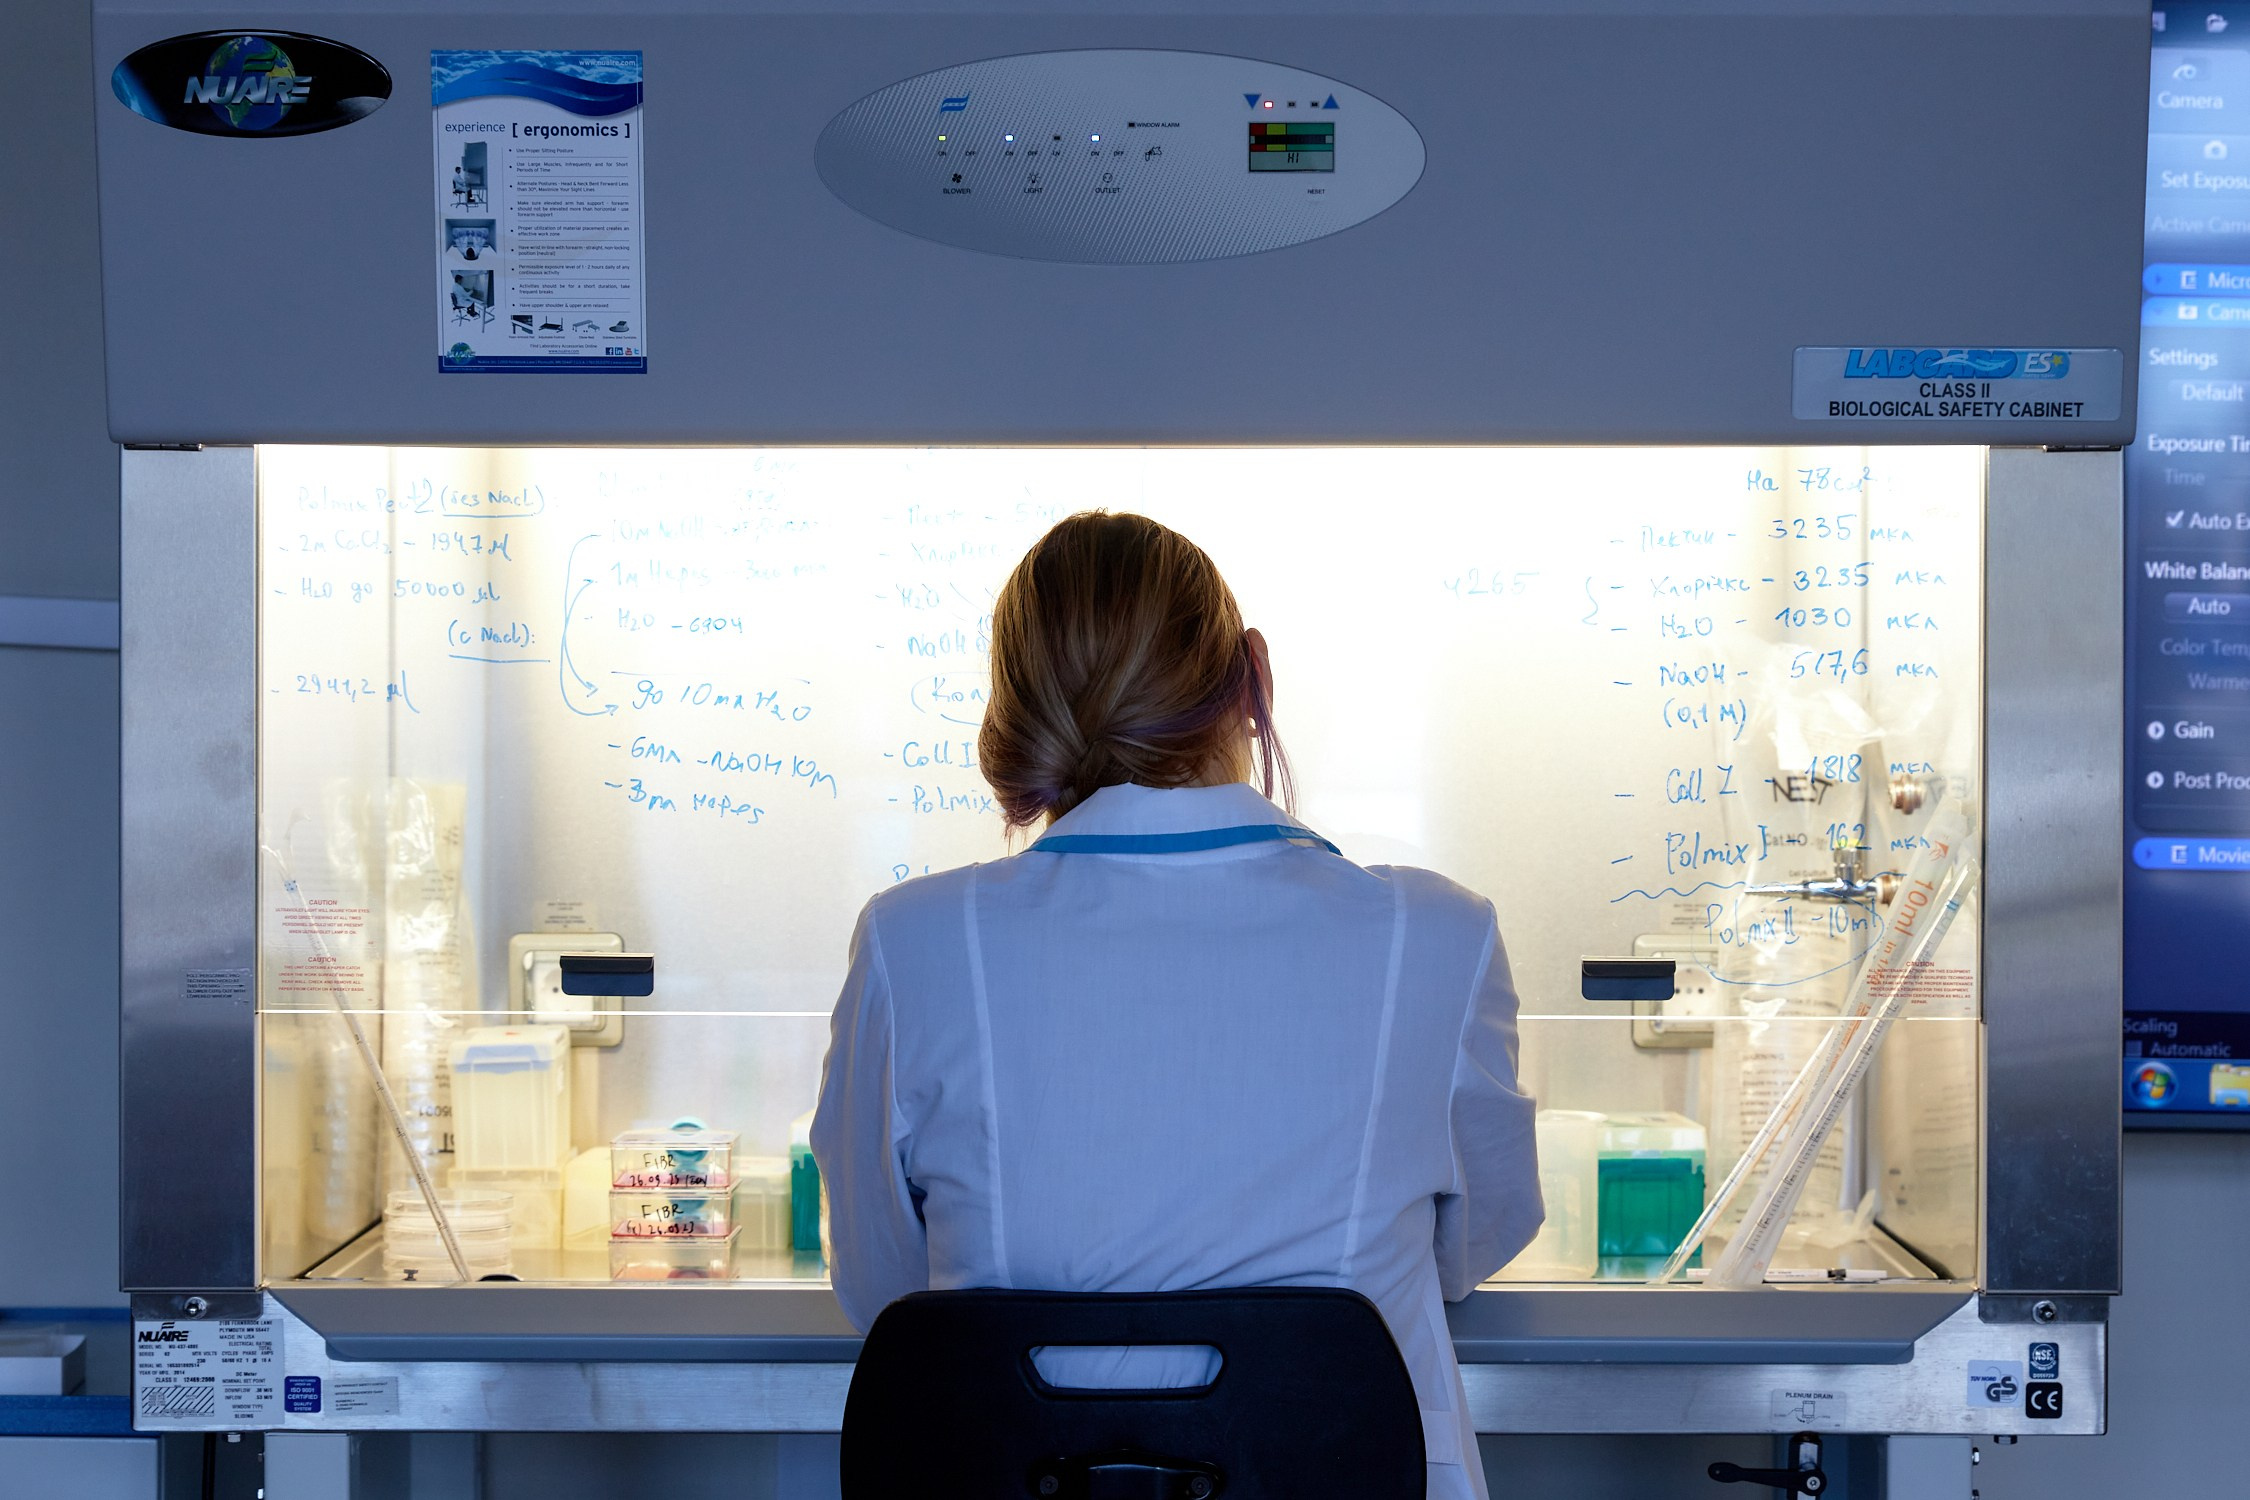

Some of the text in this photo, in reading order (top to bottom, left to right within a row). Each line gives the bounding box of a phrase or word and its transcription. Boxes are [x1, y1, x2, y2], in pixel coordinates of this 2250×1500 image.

[184, 76, 312, 104] NUAIRE
[2157, 92, 2224, 110] Camera
[445, 121, 619, 140] experience ergonomics
[1136, 121, 1180, 129] WINDOW ALARM
[1287, 152, 1300, 164] HI
[2161, 171, 2189, 188] Set
[943, 187, 971, 195] BLOWER
[1844, 349, 2053, 379] LABGARD ES
[2149, 348, 2219, 370] Settings
[1919, 382, 1991, 399] CLASS II
[2182, 383, 2244, 400] Default
[1829, 401, 2084, 418] BIOLOGICAL SAFETY CABINET
[2148, 435, 2226, 455] Exposure
[2164, 468, 2205, 486] Time
[1767, 514, 1857, 541] 3235
[2188, 512, 2232, 530] Auto
[1793, 561, 1875, 591] 3235
[2144, 561, 2250, 581] White Balan
[2187, 599, 2231, 616] Auto
[1774, 607, 1853, 628] 1030
[2160, 638, 2206, 657] Color
[2173, 720, 2214, 740] Gain
[1805, 753, 1864, 785] 1818
[2174, 770, 2212, 790] Post
[1772, 776, 1835, 806] NEST
[1894, 878, 1935, 938] 10ml
[2123, 1017, 2179, 1039] Scaling
[2150, 1041, 2232, 1058] Automatic
[138, 1330, 189, 1343] NUAIRE
[2035, 1349, 2053, 1361] NSF
[1785, 1392, 1811, 1400] PLENUM
[2031, 1390, 2059, 1411] CE
